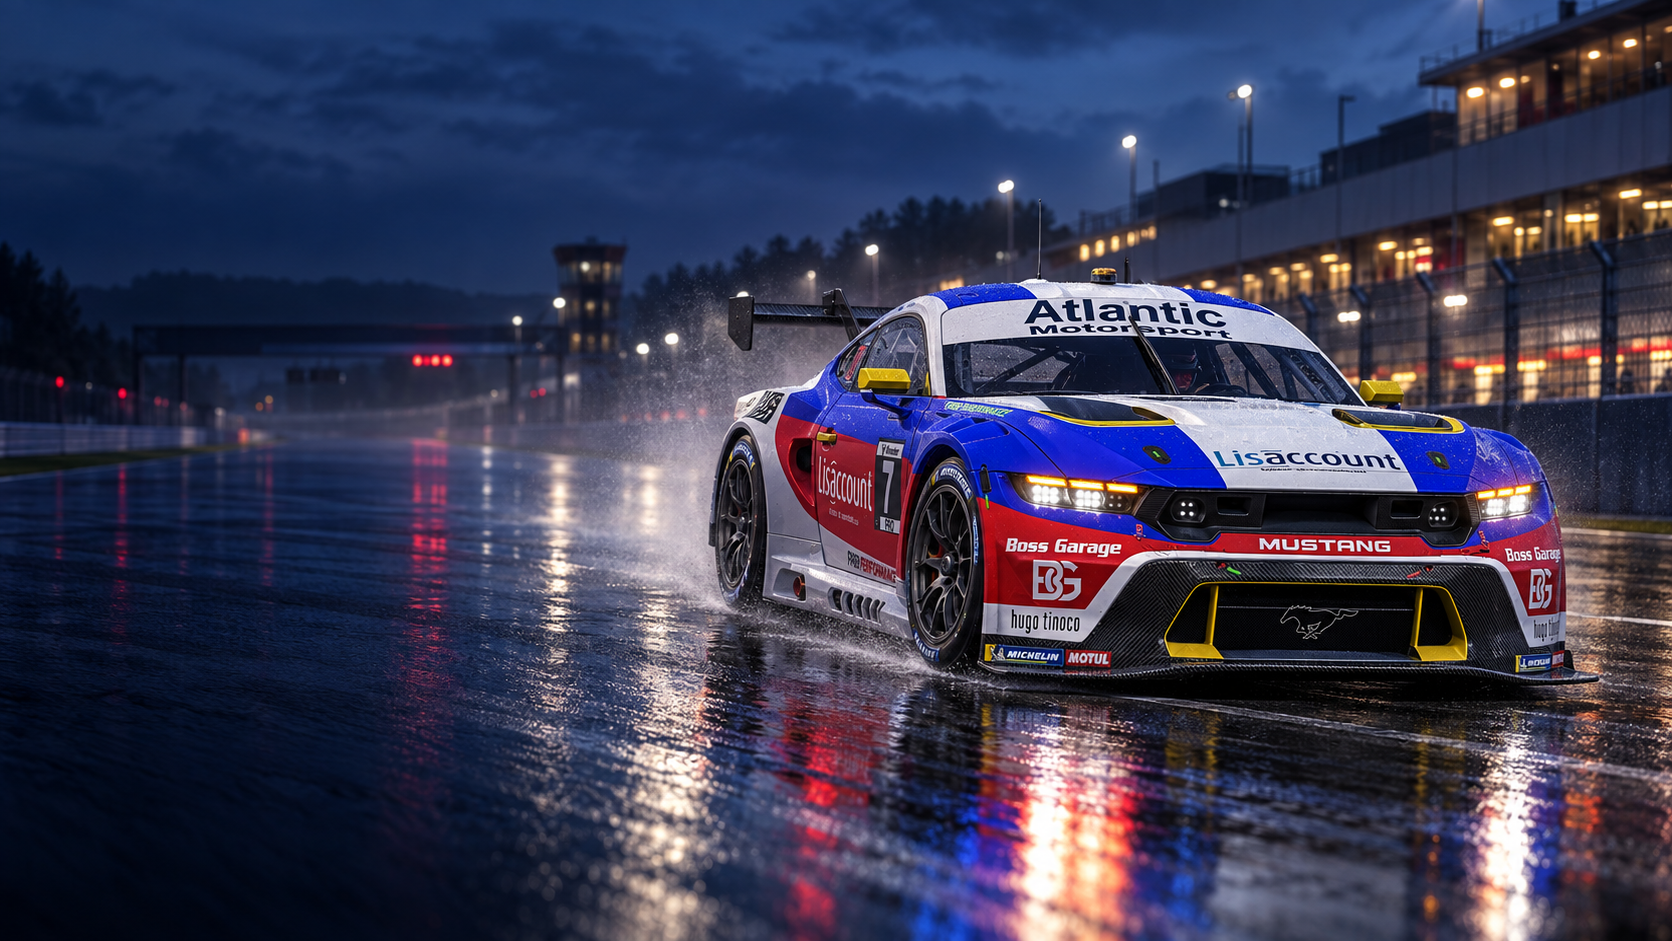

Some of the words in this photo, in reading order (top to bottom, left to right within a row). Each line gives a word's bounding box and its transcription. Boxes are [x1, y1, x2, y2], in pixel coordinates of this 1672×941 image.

[1024, 299, 1227, 327] Atlantic
[1029, 324, 1233, 339] Motorsport
[882, 460, 895, 514] 7
[1005, 538, 1049, 552] Boss
[1054, 539, 1122, 558] Garage
[1258, 538, 1391, 553] MUSTANG
[1505, 548, 1532, 562] Boss
[1533, 547, 1561, 563] Garage
[1032, 559, 1082, 601] BG
[1528, 568, 1552, 610] BG
[1011, 609, 1039, 634] hugo
[1043, 611, 1080, 632] tinoco
[1007, 650, 1060, 661] MICHELIN
[1068, 652, 1109, 665] MOTUL
